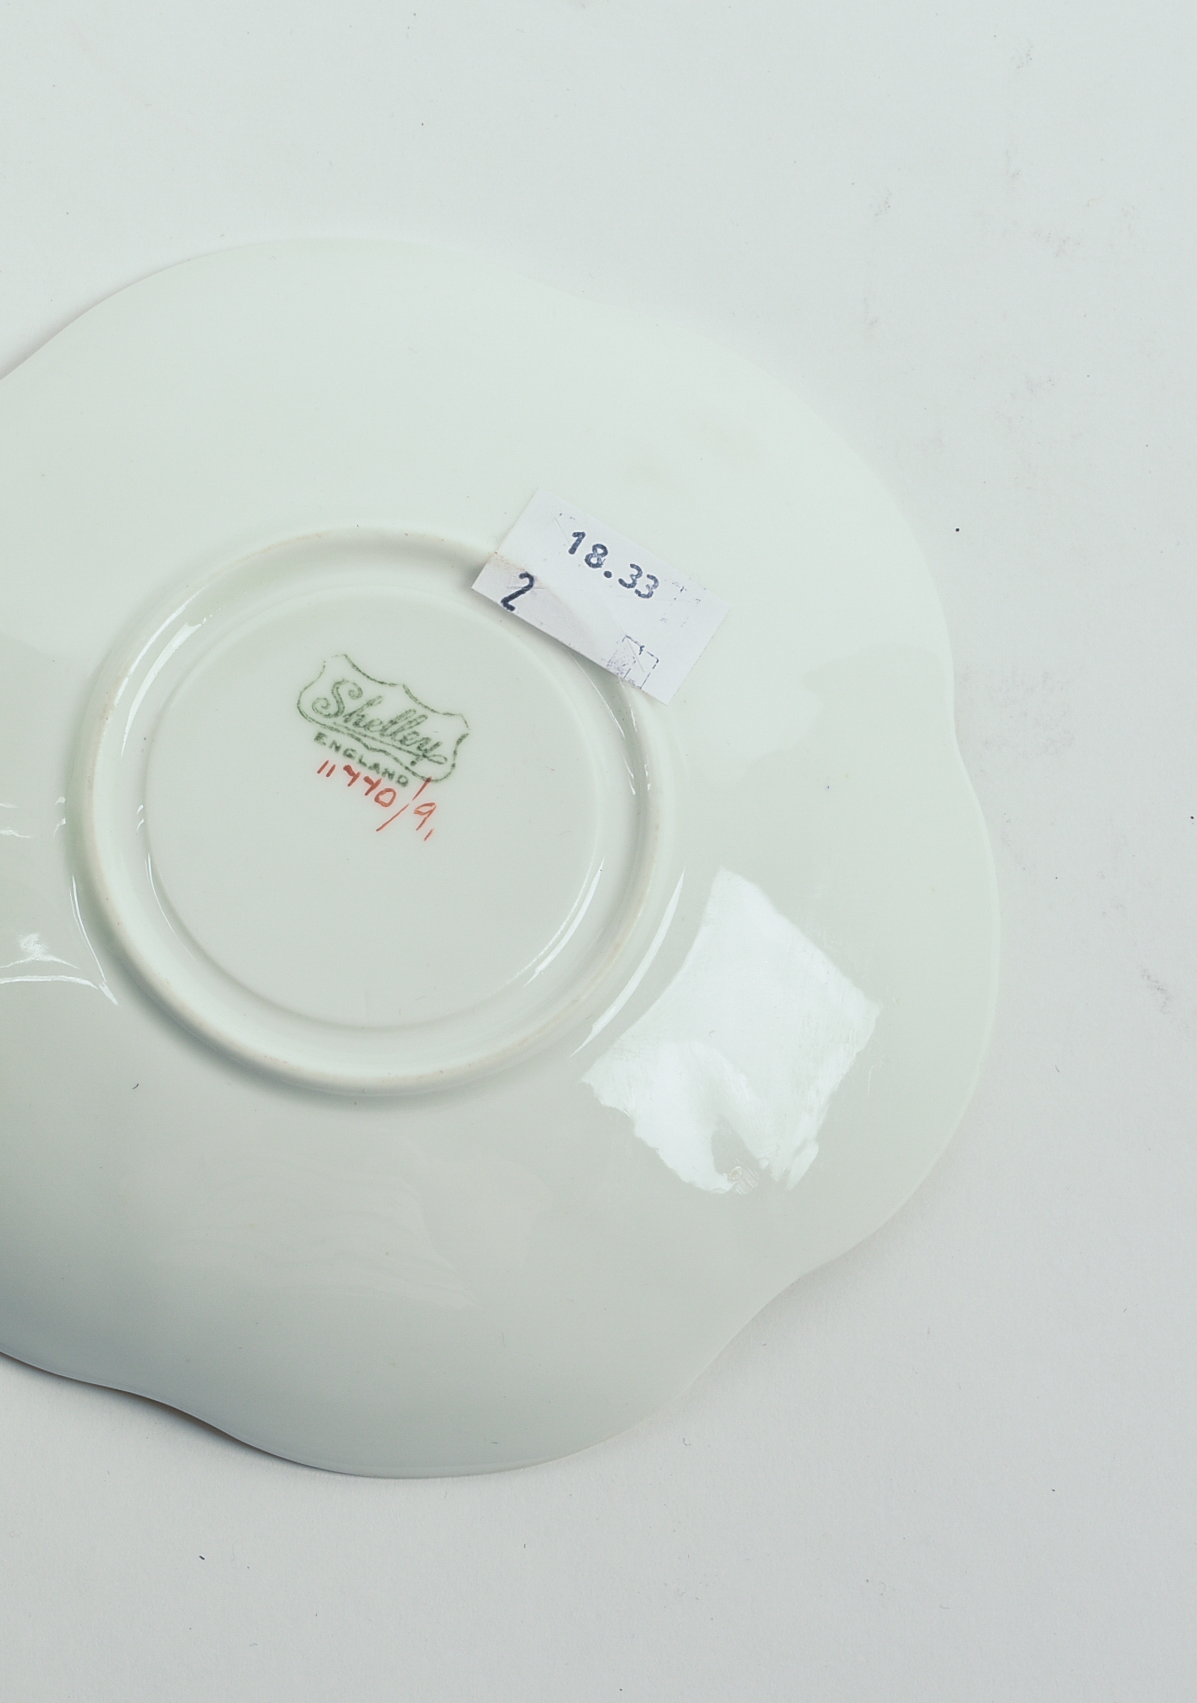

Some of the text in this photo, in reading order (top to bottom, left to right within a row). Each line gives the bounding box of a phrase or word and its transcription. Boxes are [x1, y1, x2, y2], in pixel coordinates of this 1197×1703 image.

[500, 571, 536, 612] 2
[567, 530, 660, 600] 18.33
[311, 678, 449, 767] Shelley
[314, 731, 409, 788] ENGLAND
